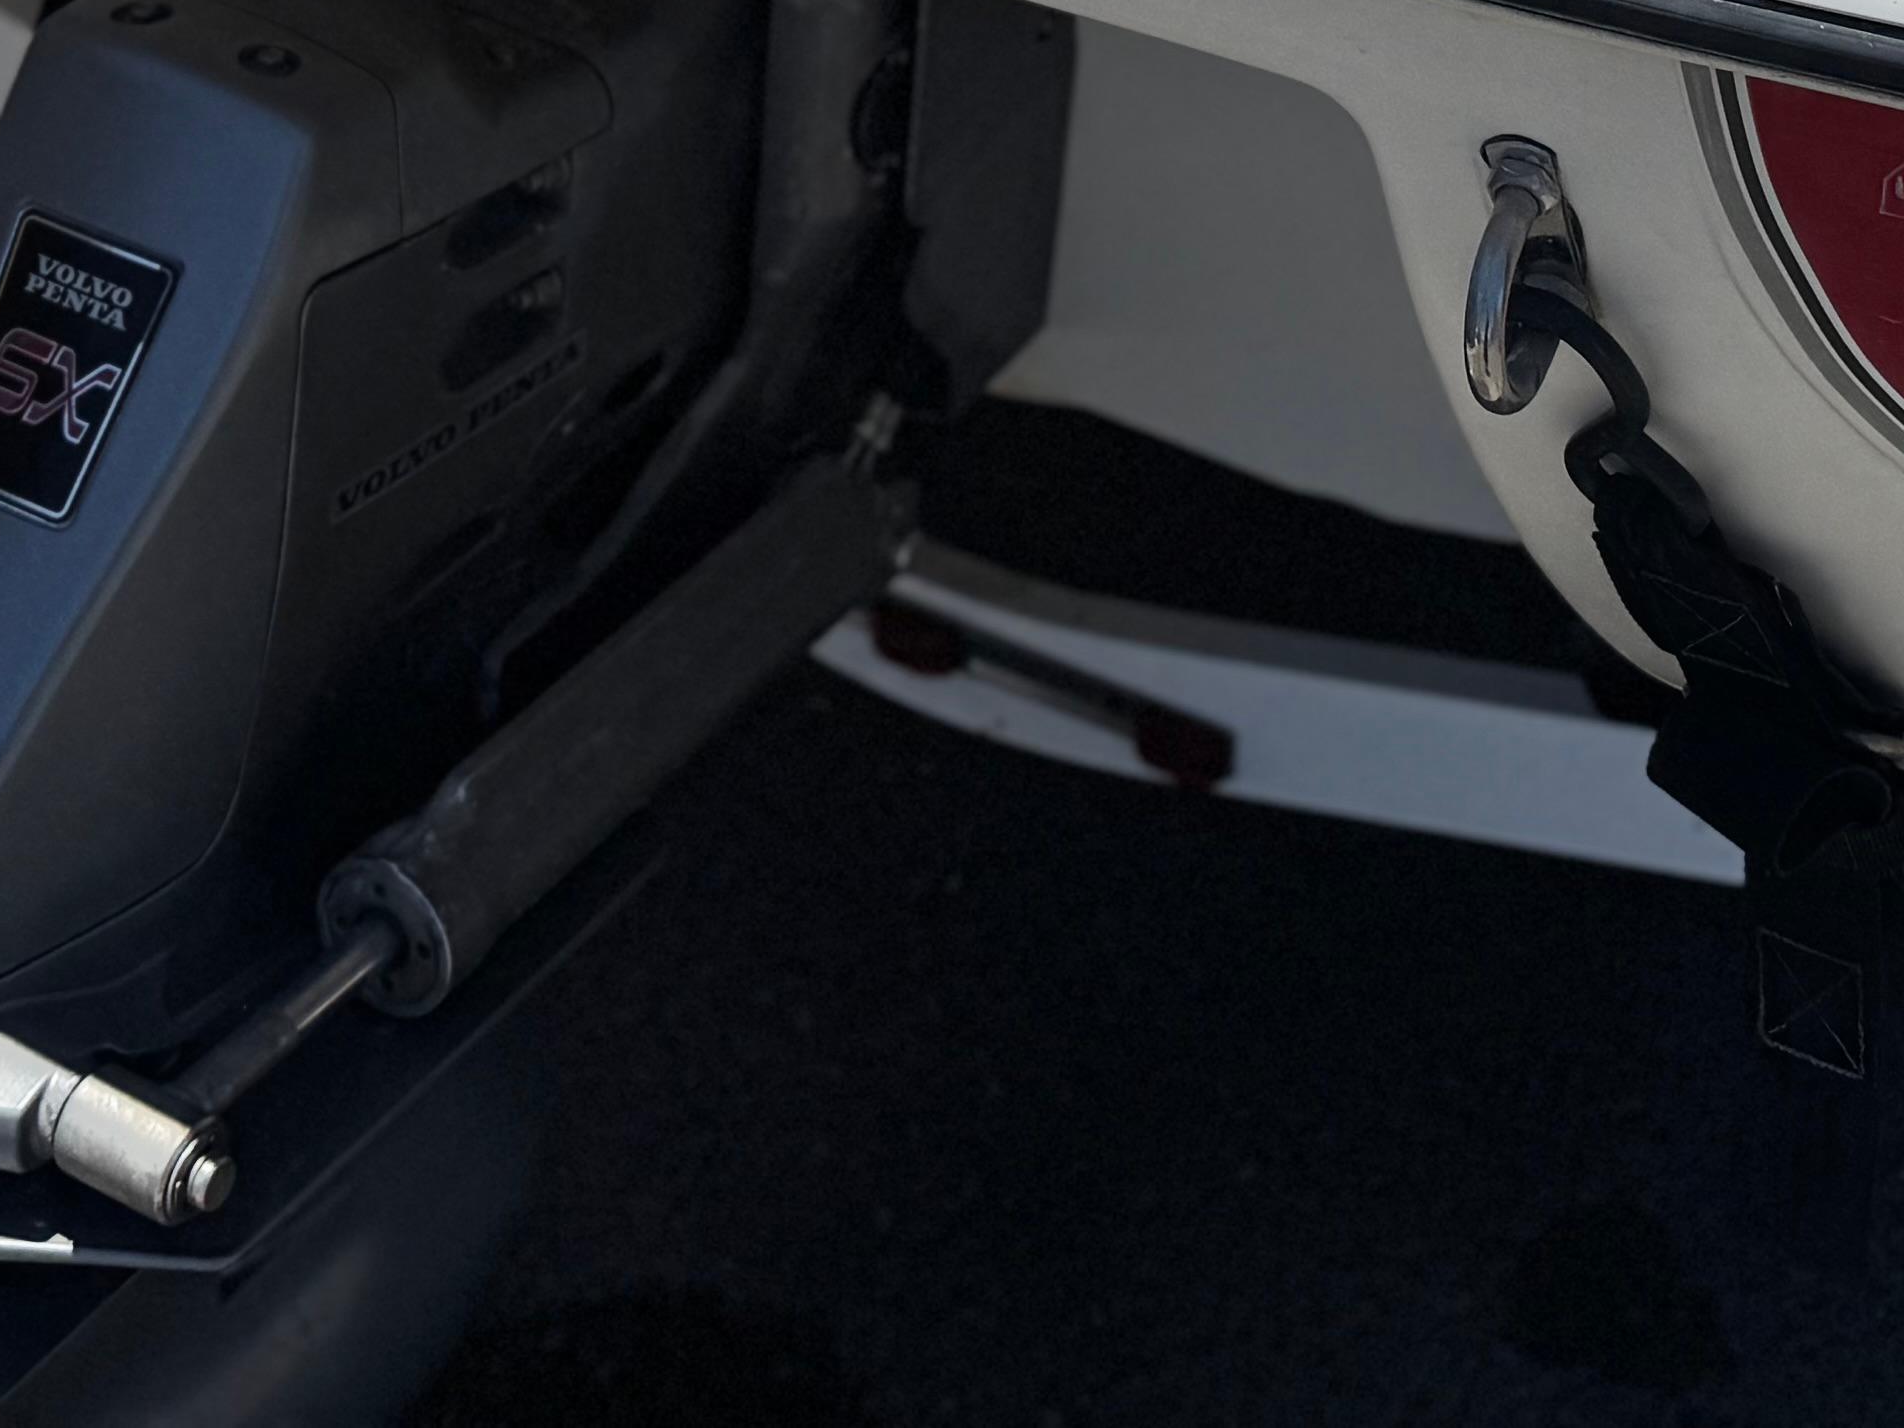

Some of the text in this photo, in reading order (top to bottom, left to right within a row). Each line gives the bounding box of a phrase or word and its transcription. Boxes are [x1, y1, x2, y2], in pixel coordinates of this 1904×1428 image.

[23, 273, 127, 332] PENTA
[38, 254, 134, 308] VOLVO
[336, 341, 579, 512] VOLVO PENTA
